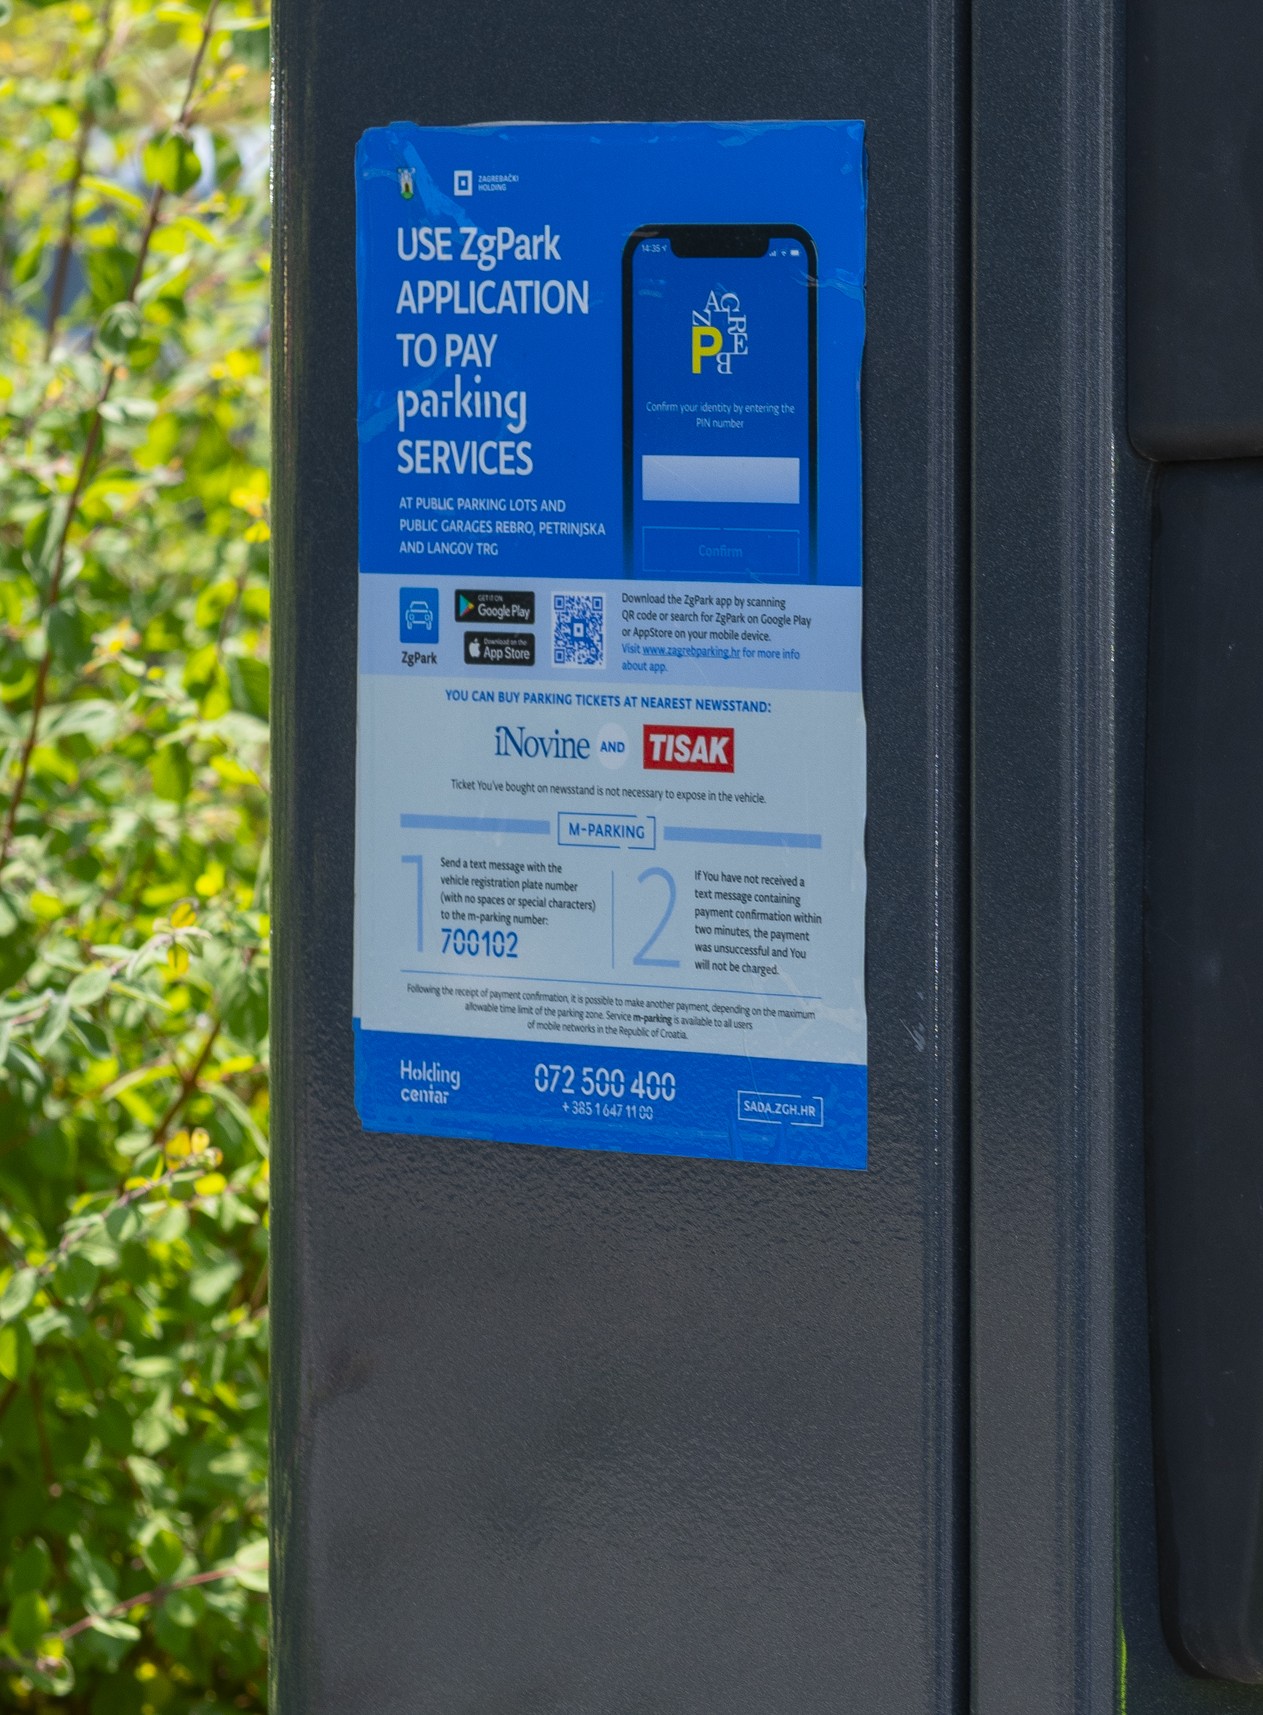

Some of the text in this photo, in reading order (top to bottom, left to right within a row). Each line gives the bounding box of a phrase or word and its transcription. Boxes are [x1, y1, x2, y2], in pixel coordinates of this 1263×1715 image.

[478, 174, 519, 183] ZAGREBAČKI
[478, 182, 507, 191] HOLDING
[397, 225, 561, 271] USE ZgPark
[396, 280, 589, 314] APPLICATION
[396, 333, 498, 367] TO PAY
[397, 374, 527, 434] parking
[397, 440, 533, 475] SERVICES
[399, 497, 566, 512] AT PUBLIC PARKING LOTS AND
[399, 519, 606, 536] PUBLIC GARAGES REBRO, PETRINJSKA
[399, 541, 498, 556] AND LANGOV TRG
[698, 544, 743, 557] Confirm
[621, 593, 786, 611] Download the ZgPark app by scanning
[477, 603, 530, 620] Google Play
[621, 609, 812, 629] QR code or search for ZgPark on Google Play
[621, 627, 771, 642] or AppStore on your mobile device.
[401, 651, 437, 667] ZgPark
[483, 646, 530, 661] App Store
[445, 690, 771, 713] YOU CAN BUY PARKING TICKETS AT NEAREST NEWSSTAND:
[495, 726, 590, 759] iNovine
[600, 741, 625, 753] AND
[649, 734, 730, 764] TISAK
[569, 822, 645, 839] M-PARKING
[440, 857, 562, 874] Send a text message with the
[440, 875, 578, 892] vehicle registration plate number
[694, 870, 805, 888] If You have not received a
[400, 855, 424, 952] 1
[440, 891, 596, 912] (with no spaces or special characters)
[694, 889, 801, 908] text message containing
[440, 910, 548, 926] to the m-parking number:
[632, 867, 681, 968] 2
[694, 908, 822, 924] payment confirmation within
[694, 925, 810, 942] two minutes, the payment
[441, 928, 518, 958] 700102
[694, 944, 807, 959] was unsuccessful and You
[694, 959, 779, 977] will not be charged.
[400, 1060, 460, 1090] Holding
[534, 1064, 676, 1101] 072 500 400
[400, 1084, 449, 1104] centar
[744, 1101, 816, 1116] SADA.ZGH.HR
